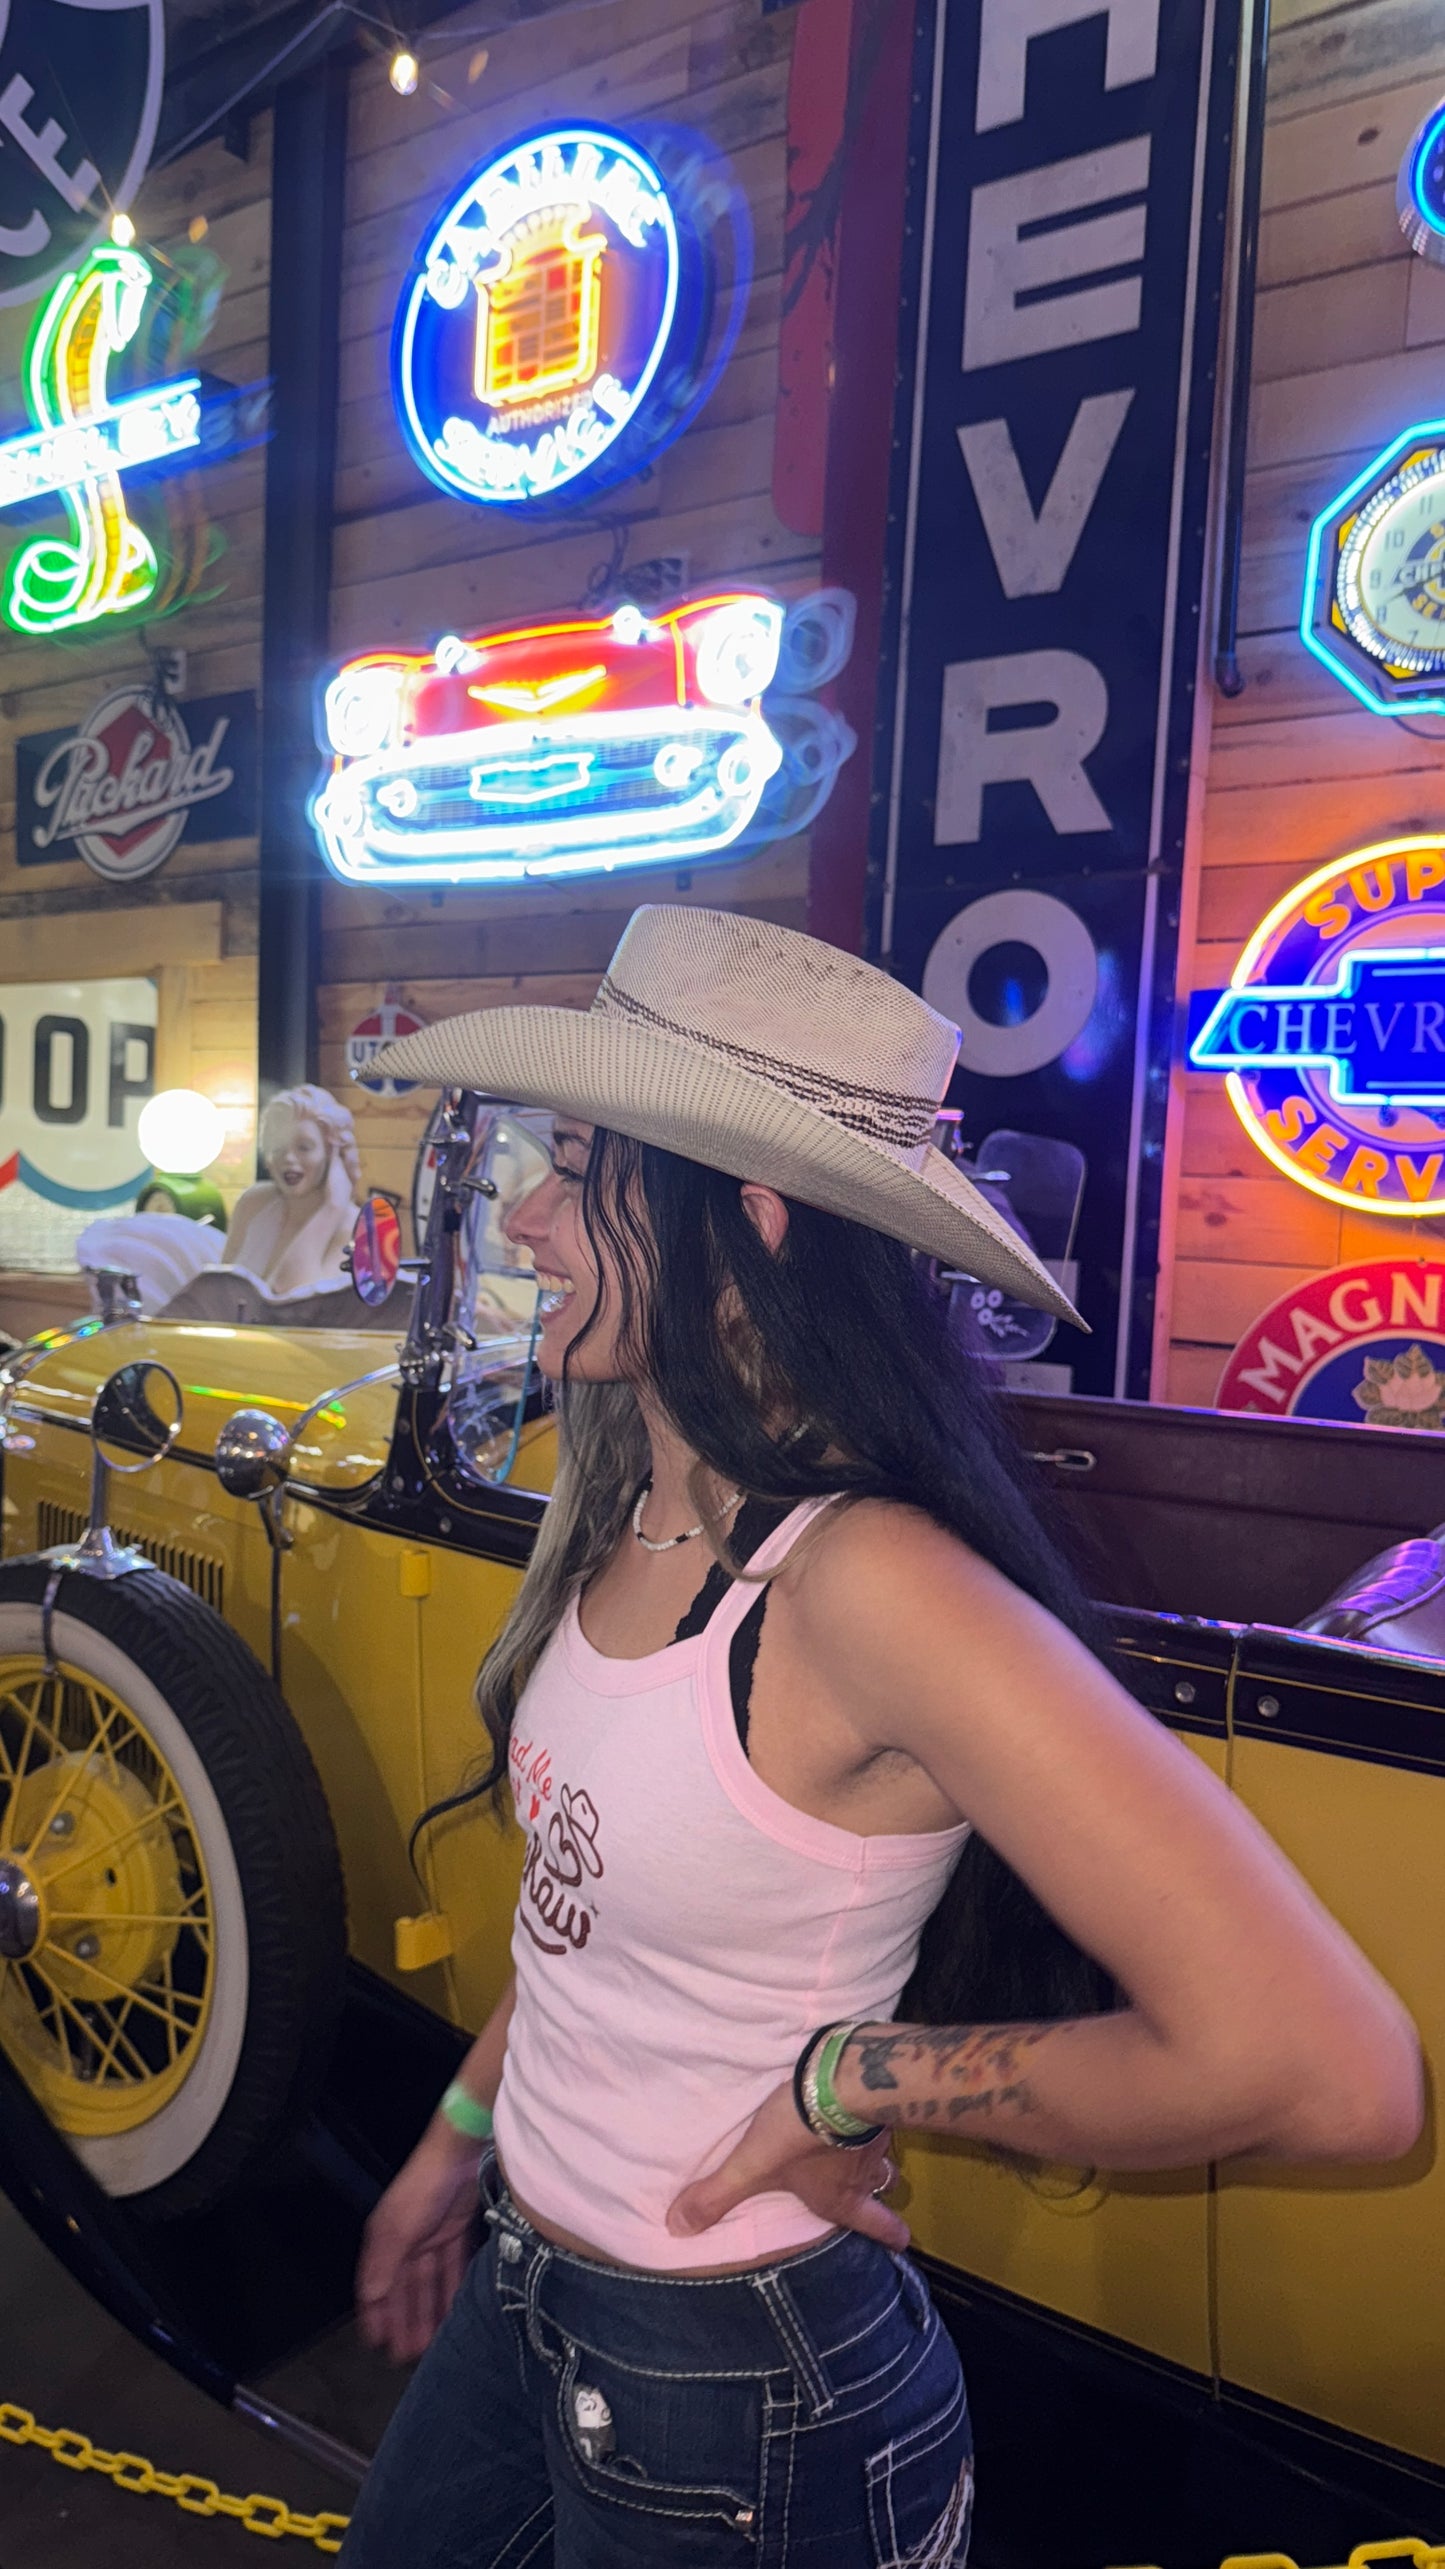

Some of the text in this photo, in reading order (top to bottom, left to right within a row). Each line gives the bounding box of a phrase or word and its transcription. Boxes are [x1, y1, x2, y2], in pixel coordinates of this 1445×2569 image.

[33, 716, 234, 848] Packard
[1303, 851, 1445, 940] SUP
[0, 1012, 156, 1128] OP
[1228, 1001, 1445, 1054] CHEVR
[1266, 1095, 1444, 1203] SERV
[1237, 1271, 1442, 1404] MAGN
